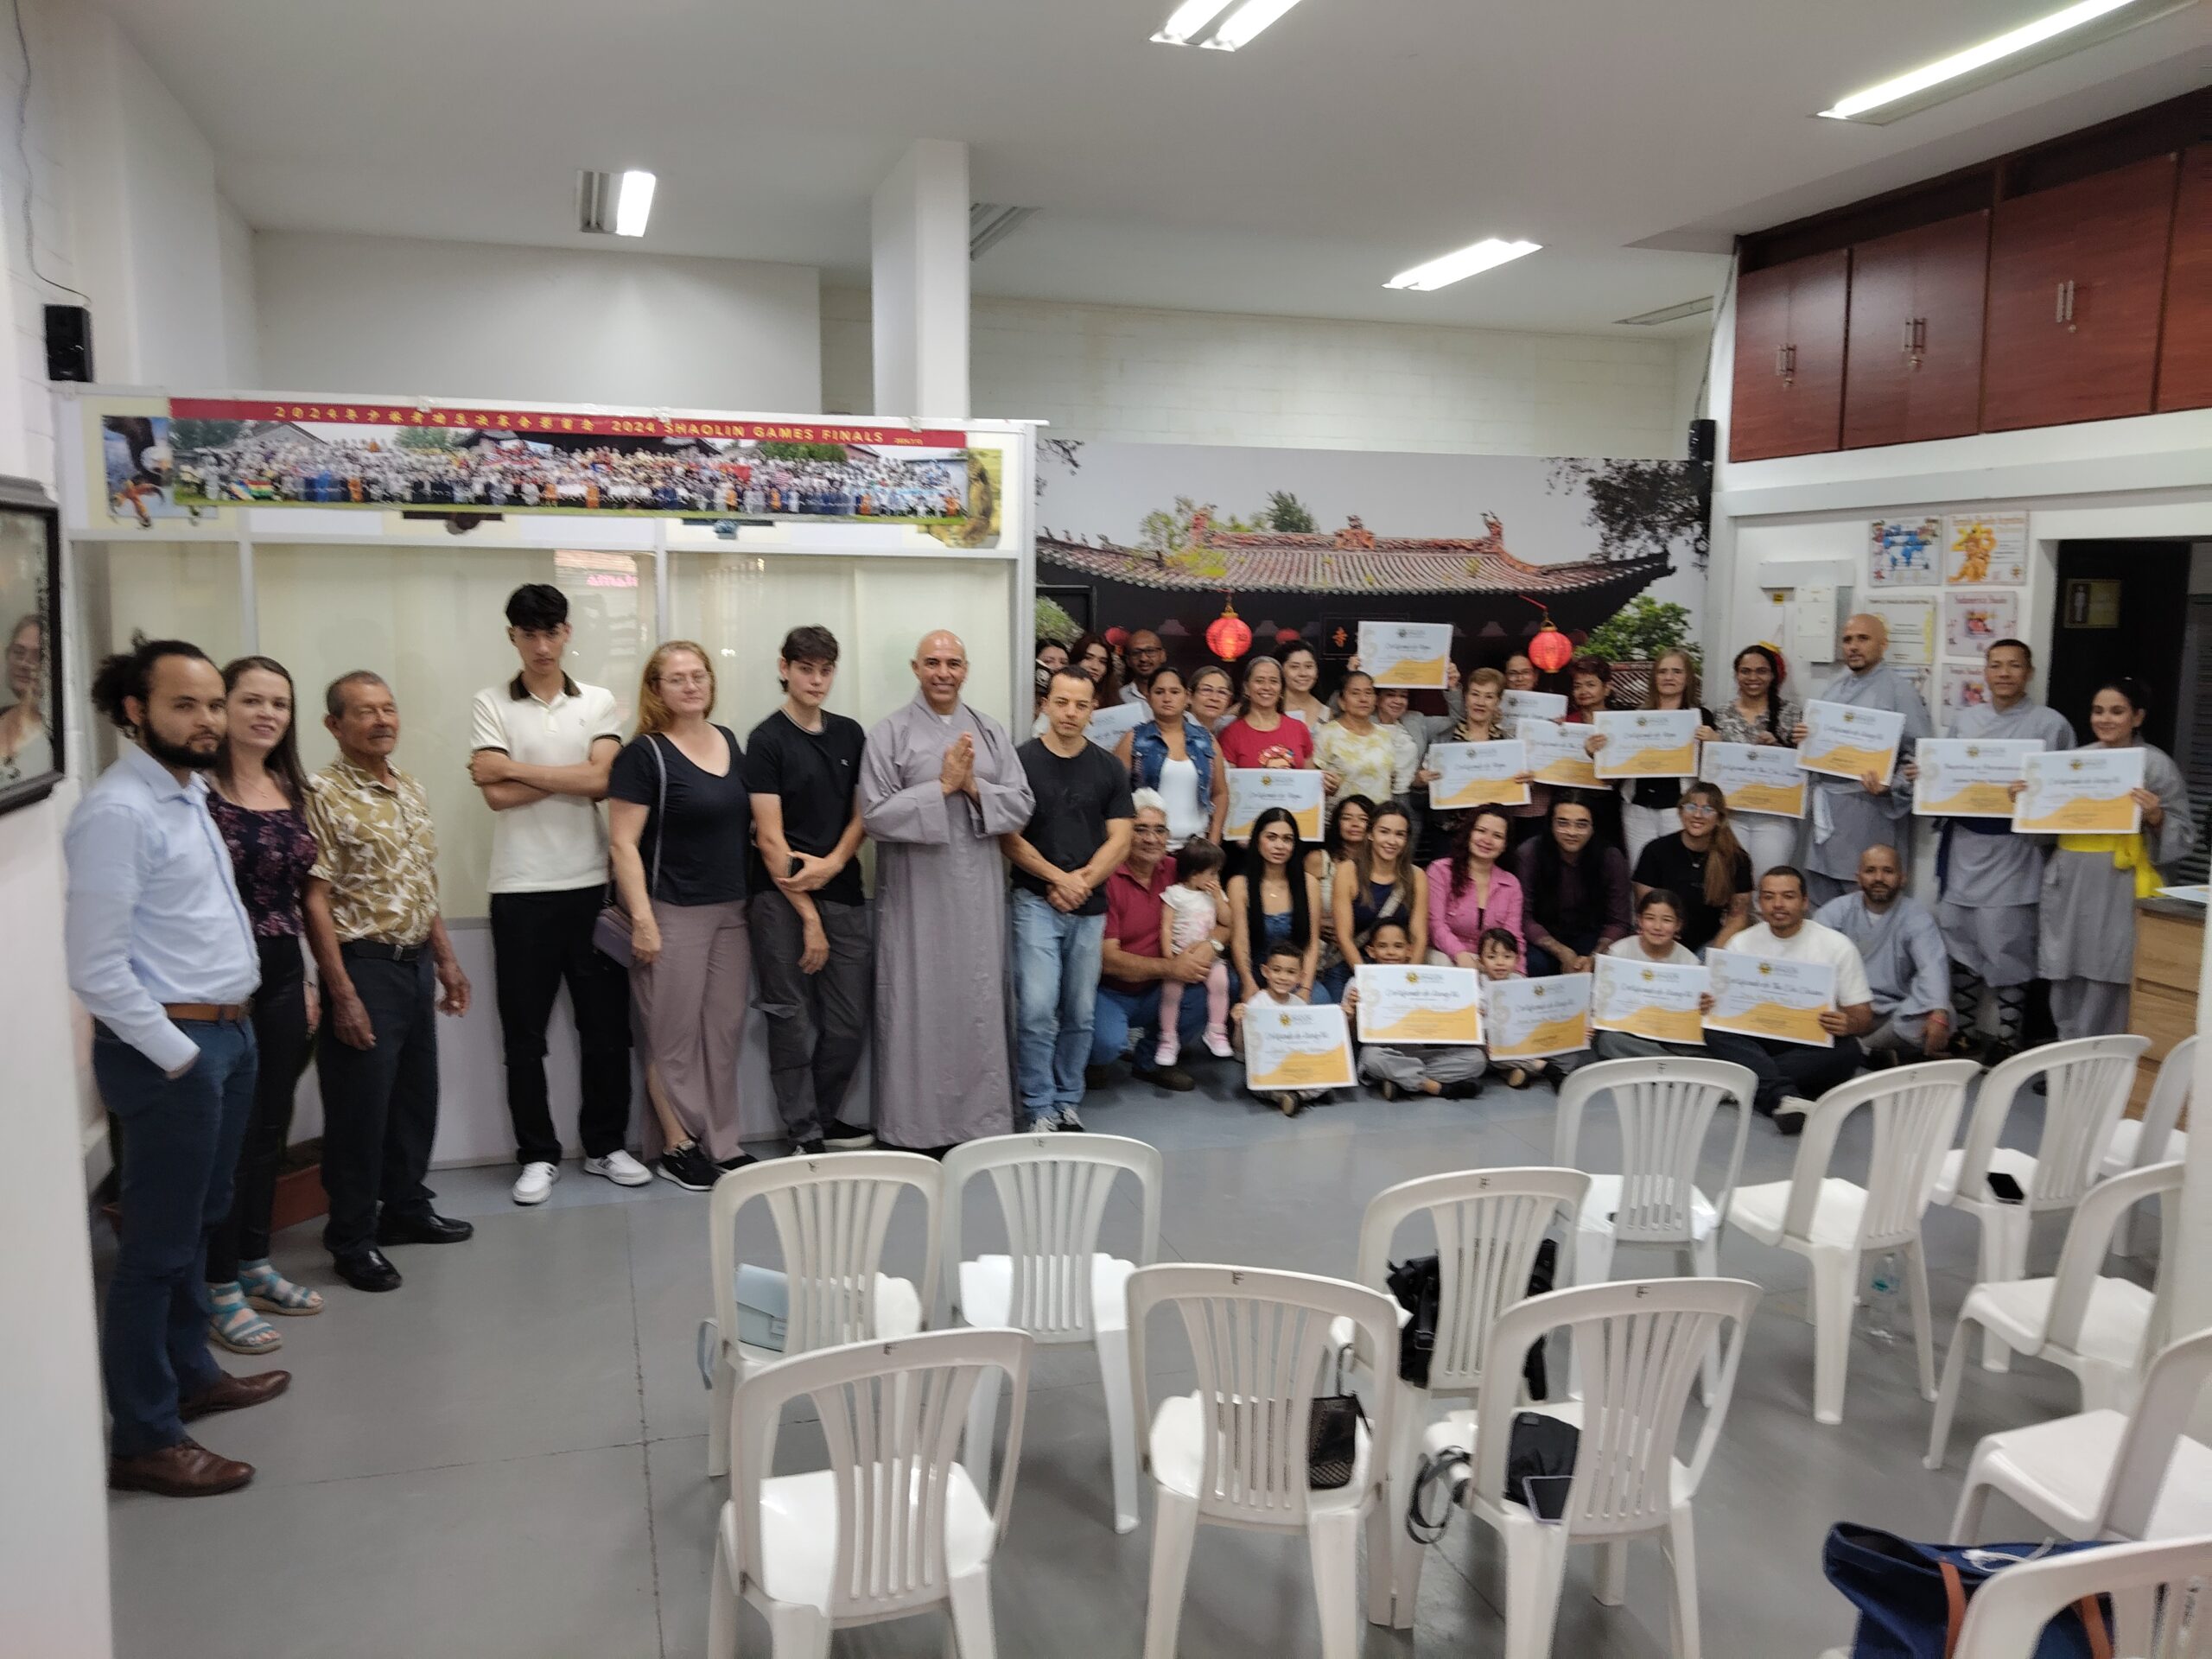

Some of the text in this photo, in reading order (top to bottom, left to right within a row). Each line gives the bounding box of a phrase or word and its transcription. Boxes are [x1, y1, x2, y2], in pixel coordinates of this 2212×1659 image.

[611, 420, 656, 434] 2024
[664, 422, 745, 437] SHAOLIN
[753, 425, 814, 441] GAMES
[822, 429, 884, 443] FINALS
